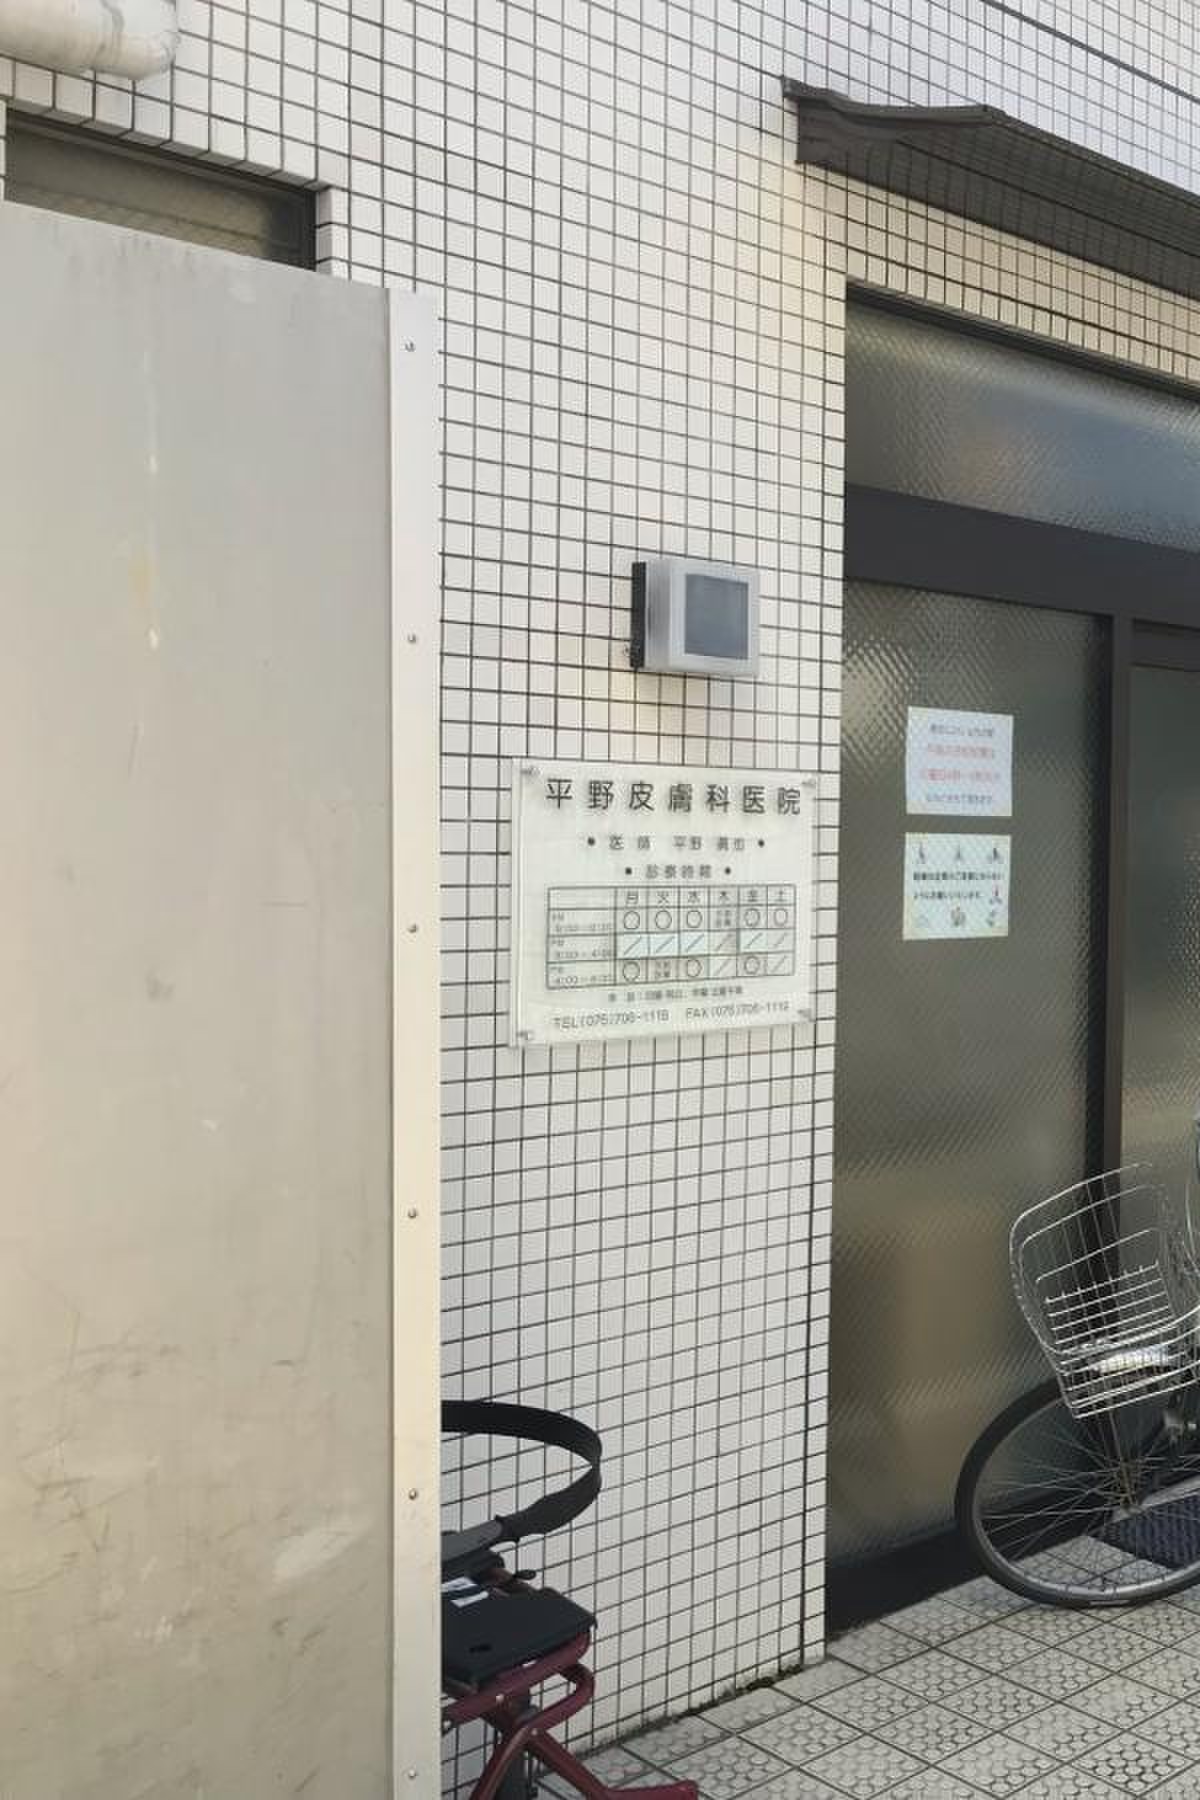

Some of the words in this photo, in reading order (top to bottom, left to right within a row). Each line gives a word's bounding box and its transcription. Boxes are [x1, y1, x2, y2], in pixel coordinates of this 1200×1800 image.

[546, 778, 801, 815] 平野皮膚科医院
